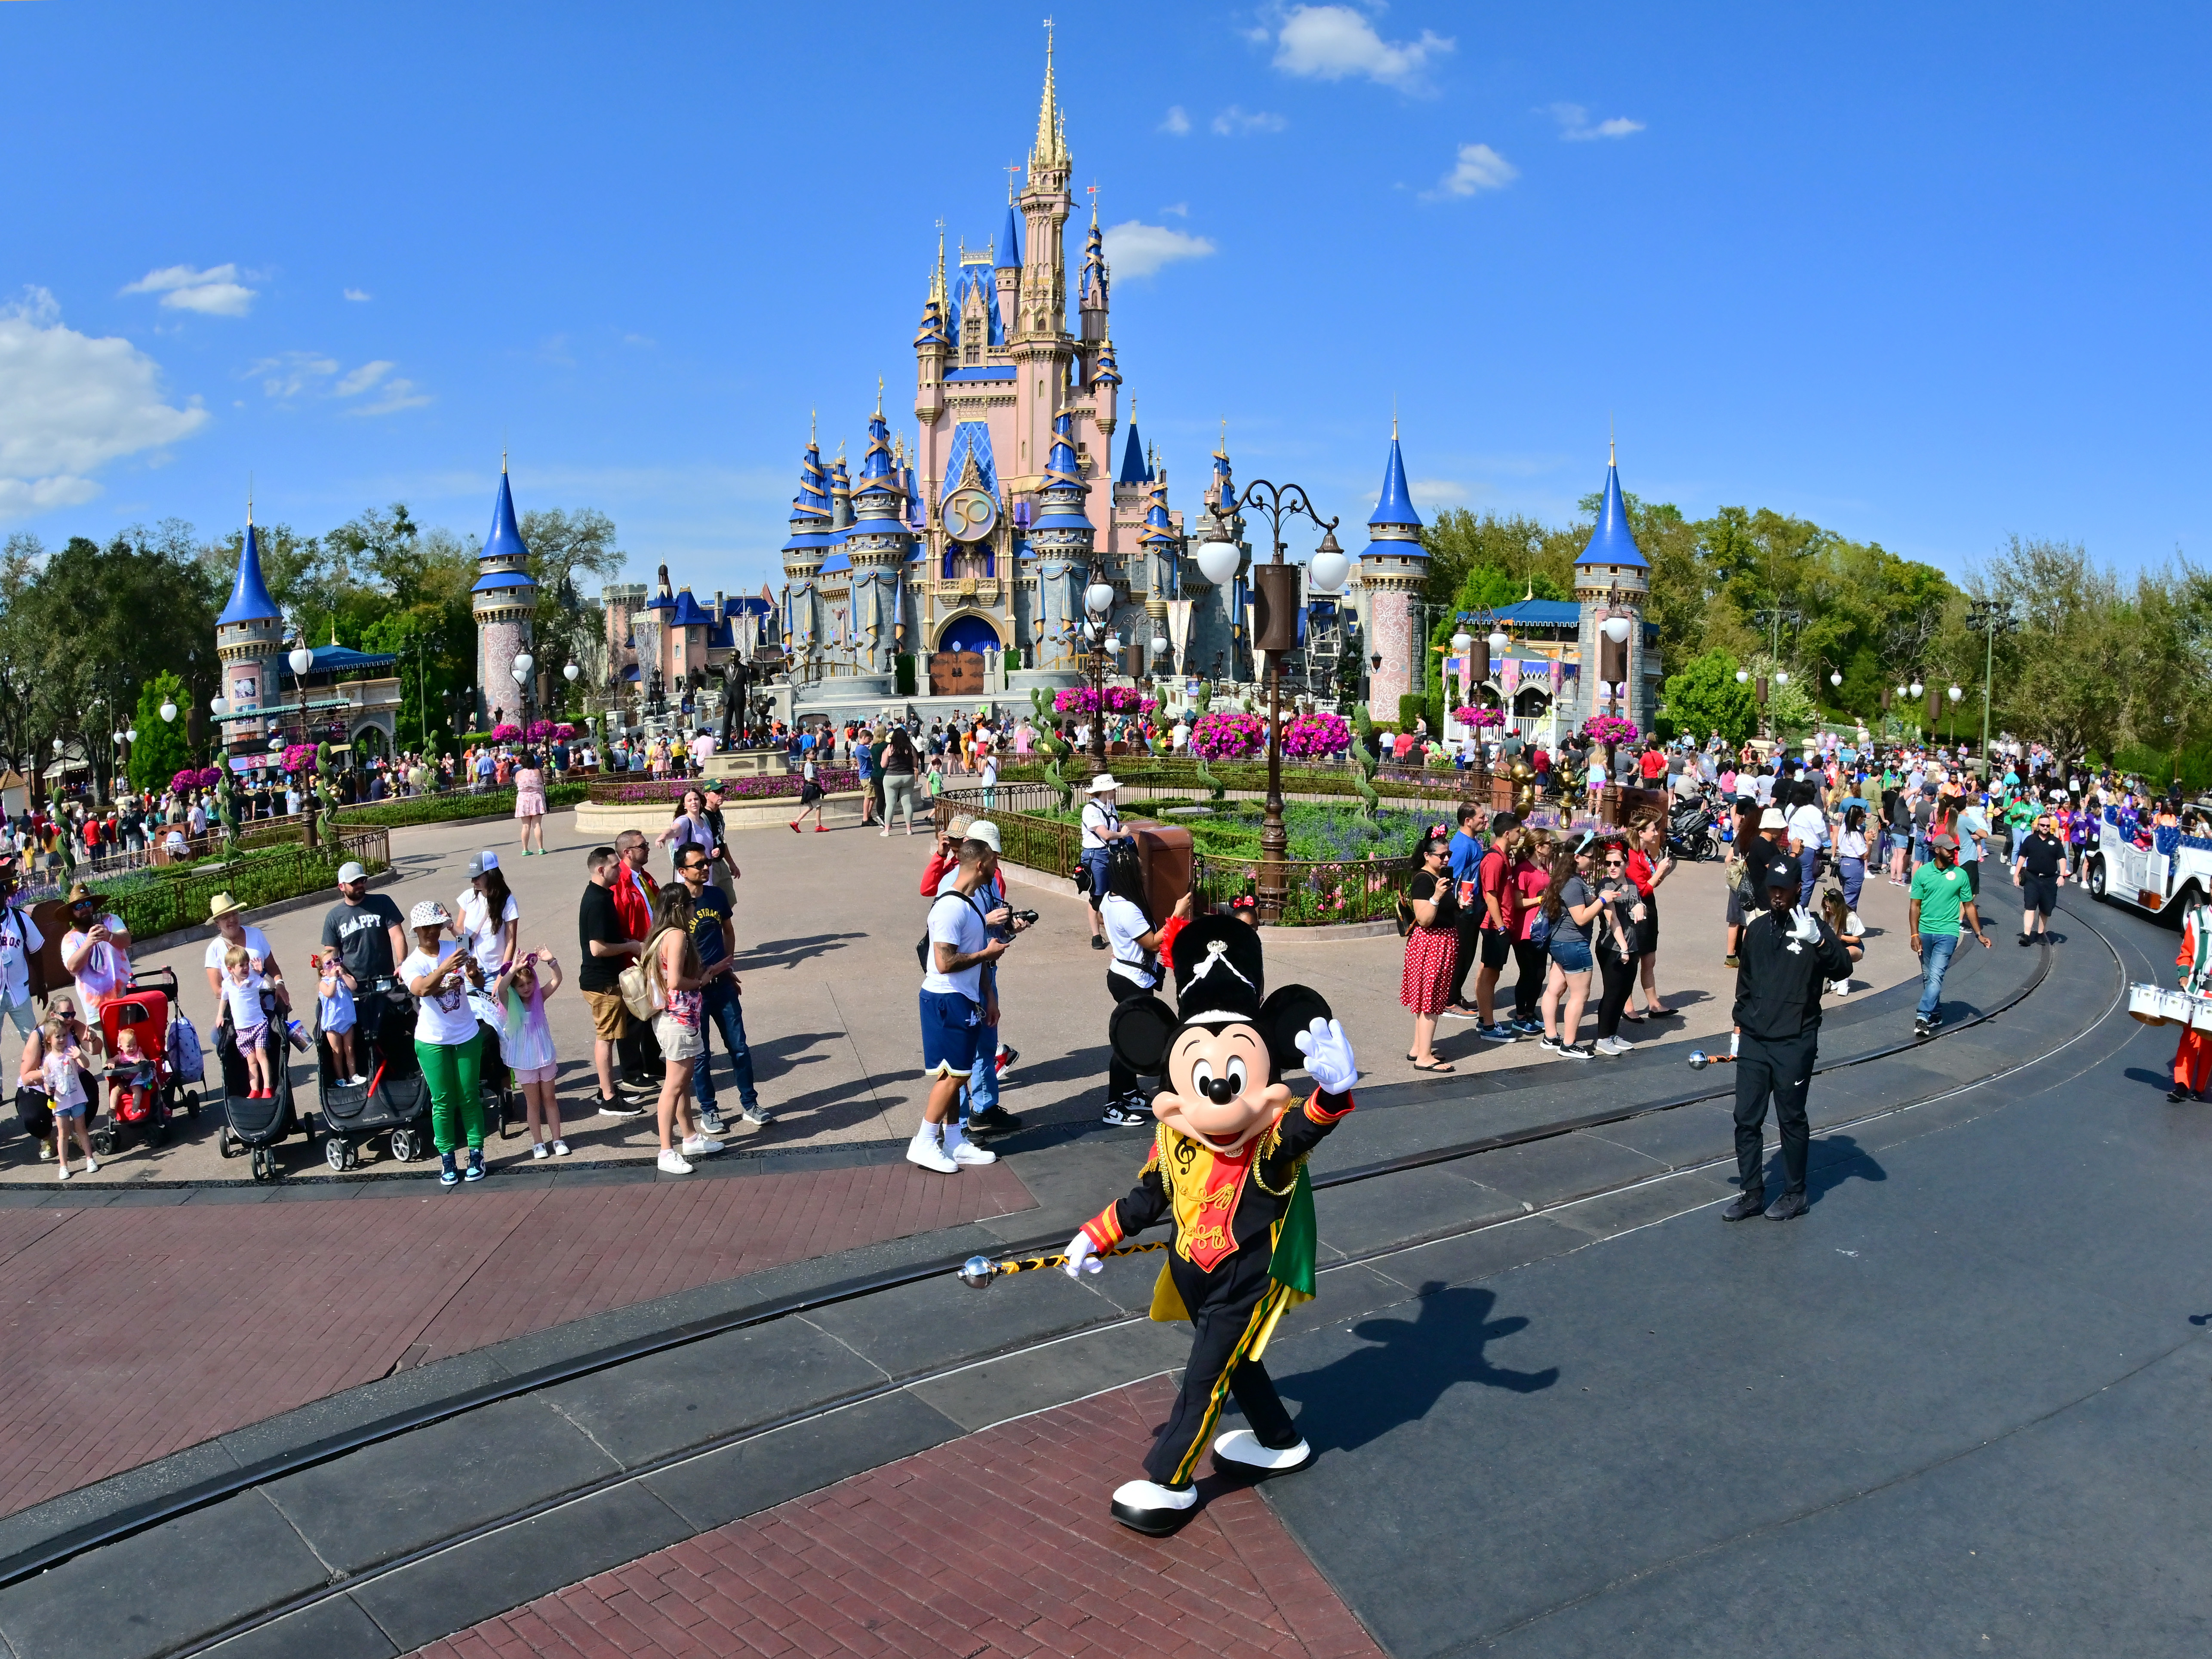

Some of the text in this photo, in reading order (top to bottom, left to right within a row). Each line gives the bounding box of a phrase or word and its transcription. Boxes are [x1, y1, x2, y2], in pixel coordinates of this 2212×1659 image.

[954, 497, 989, 535] 50
[1383, 659, 1400, 677] 50
[496, 690, 512, 708] 50
[688, 917, 699, 933] LEVI
[0, 936, 20, 949] ROS
